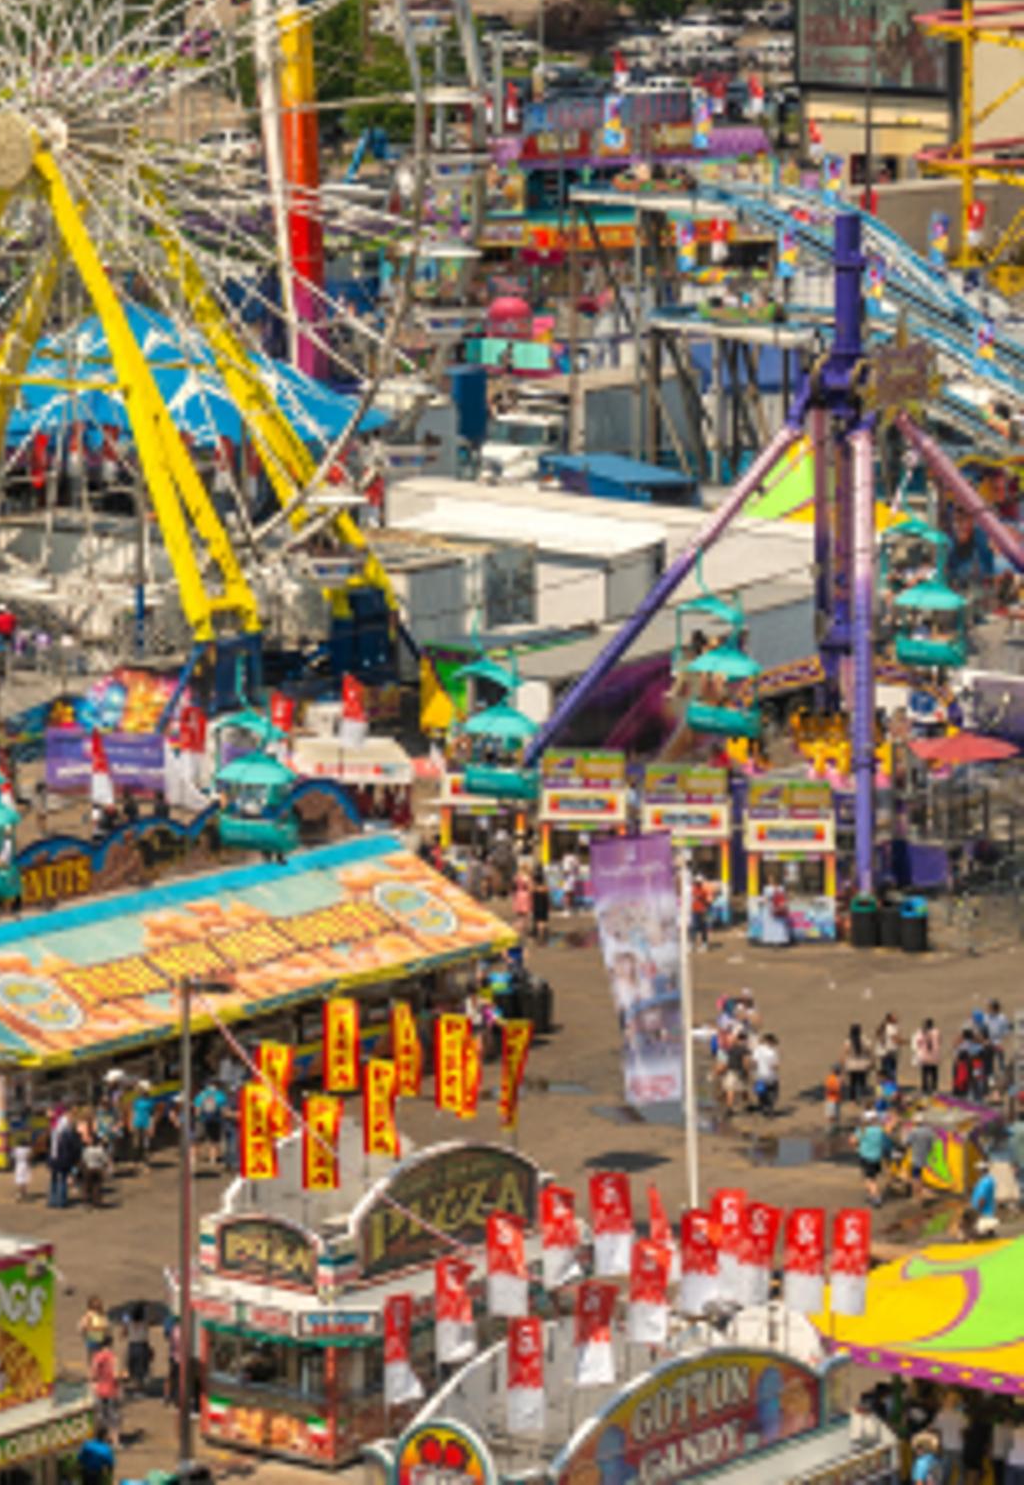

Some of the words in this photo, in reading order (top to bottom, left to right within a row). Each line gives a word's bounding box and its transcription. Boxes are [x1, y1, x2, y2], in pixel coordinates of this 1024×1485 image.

[368, 1172, 526, 1262] PIZZA
[632, 1365, 750, 1442] COTTON
[639, 1418, 741, 1483] CANDY
